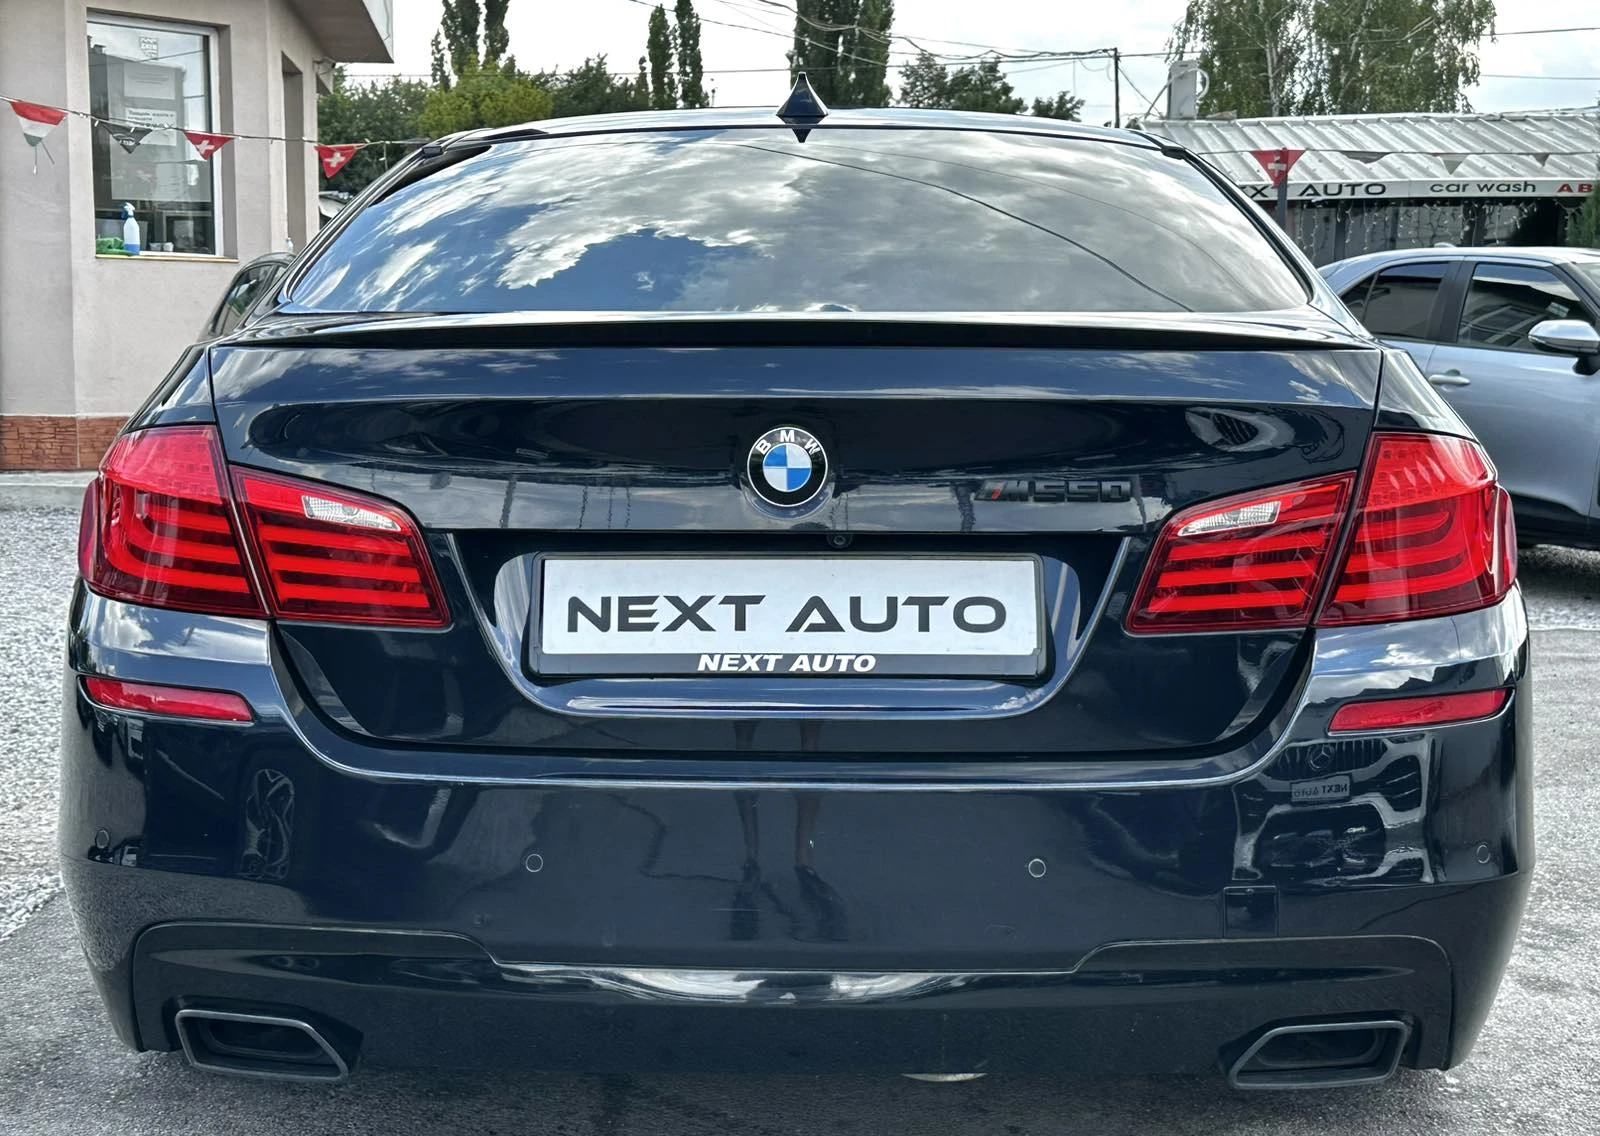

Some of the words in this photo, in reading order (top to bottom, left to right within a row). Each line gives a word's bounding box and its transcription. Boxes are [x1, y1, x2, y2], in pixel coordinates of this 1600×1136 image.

[1298, 183, 1387, 197] AUTO
[1429, 183, 1469, 193] car
[1477, 181, 1537, 193] wash
[755, 429, 821, 456] BMW
[566, 594, 766, 633] NEXT
[784, 594, 1007, 633] AUTO
[697, 653, 783, 672] NEXT
[788, 653, 877, 673] AUTO
